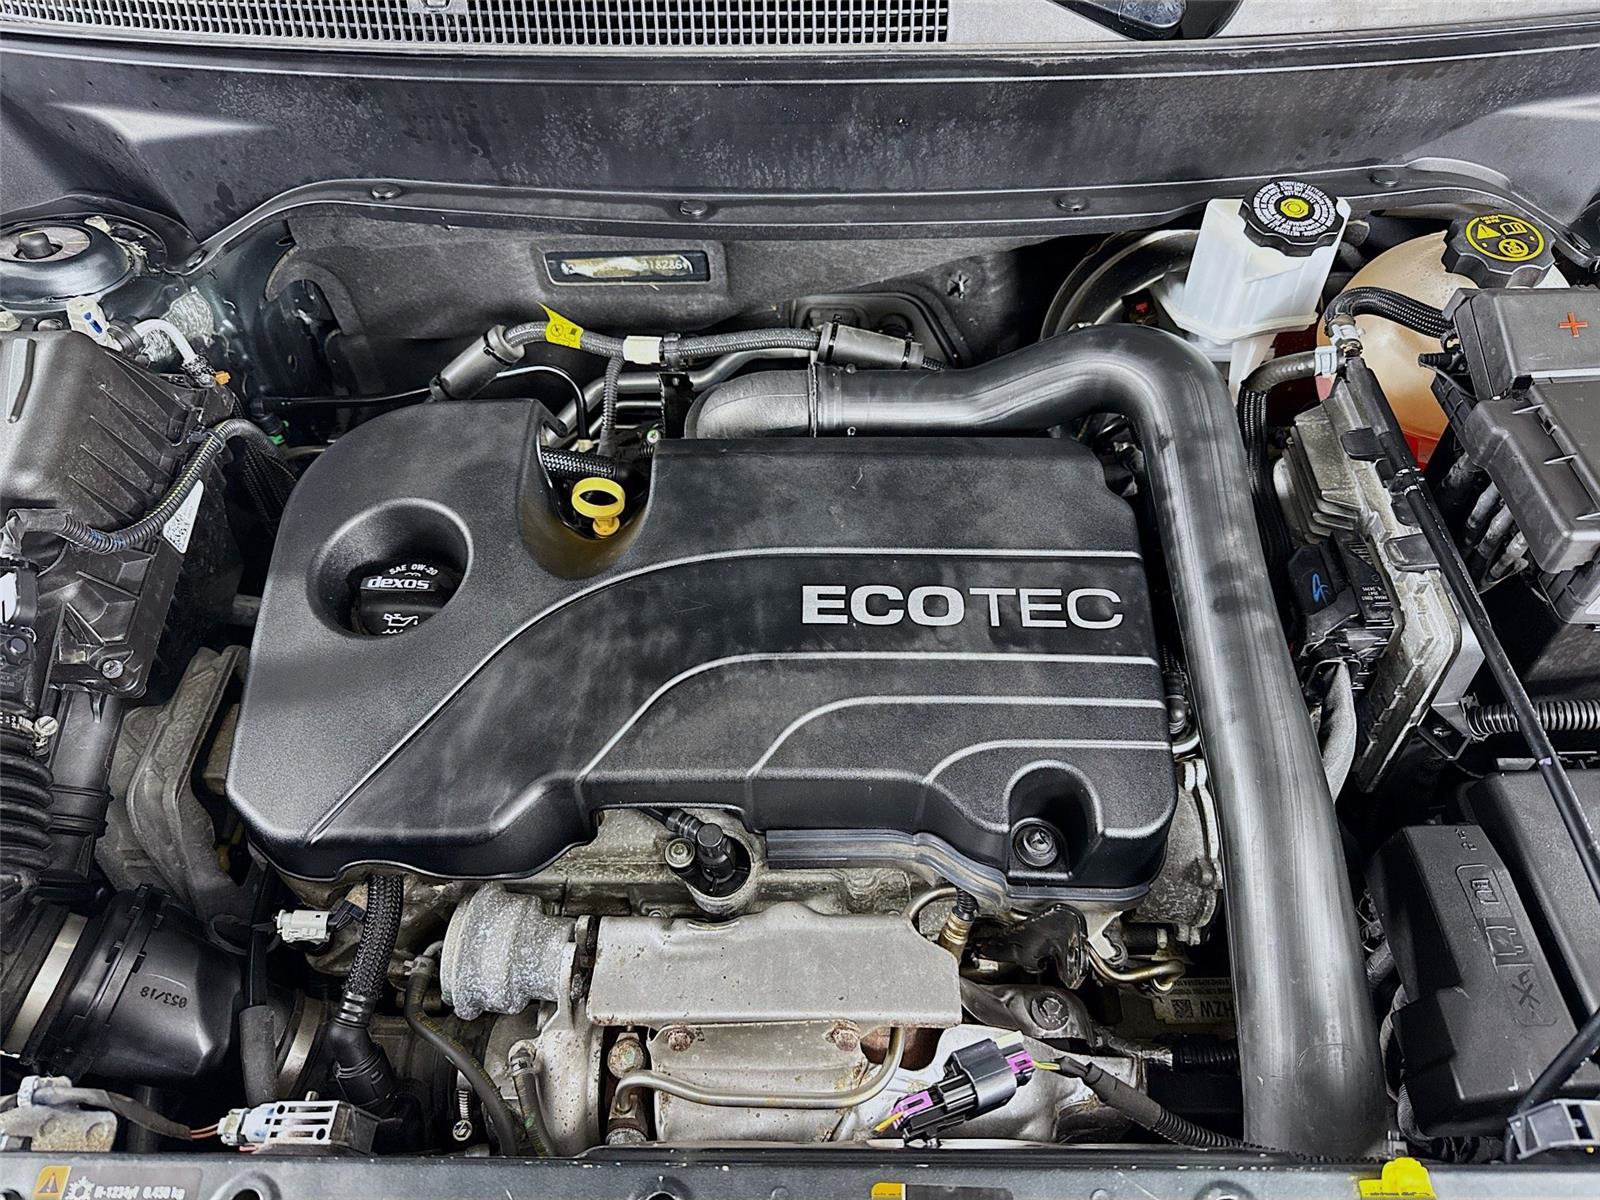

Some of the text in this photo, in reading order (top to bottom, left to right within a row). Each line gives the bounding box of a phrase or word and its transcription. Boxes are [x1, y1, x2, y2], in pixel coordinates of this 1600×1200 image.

[388, 564, 407, 575] SAE
[366, 575, 431, 590] dexos
[801, 584, 1124, 630] ECOTEC
